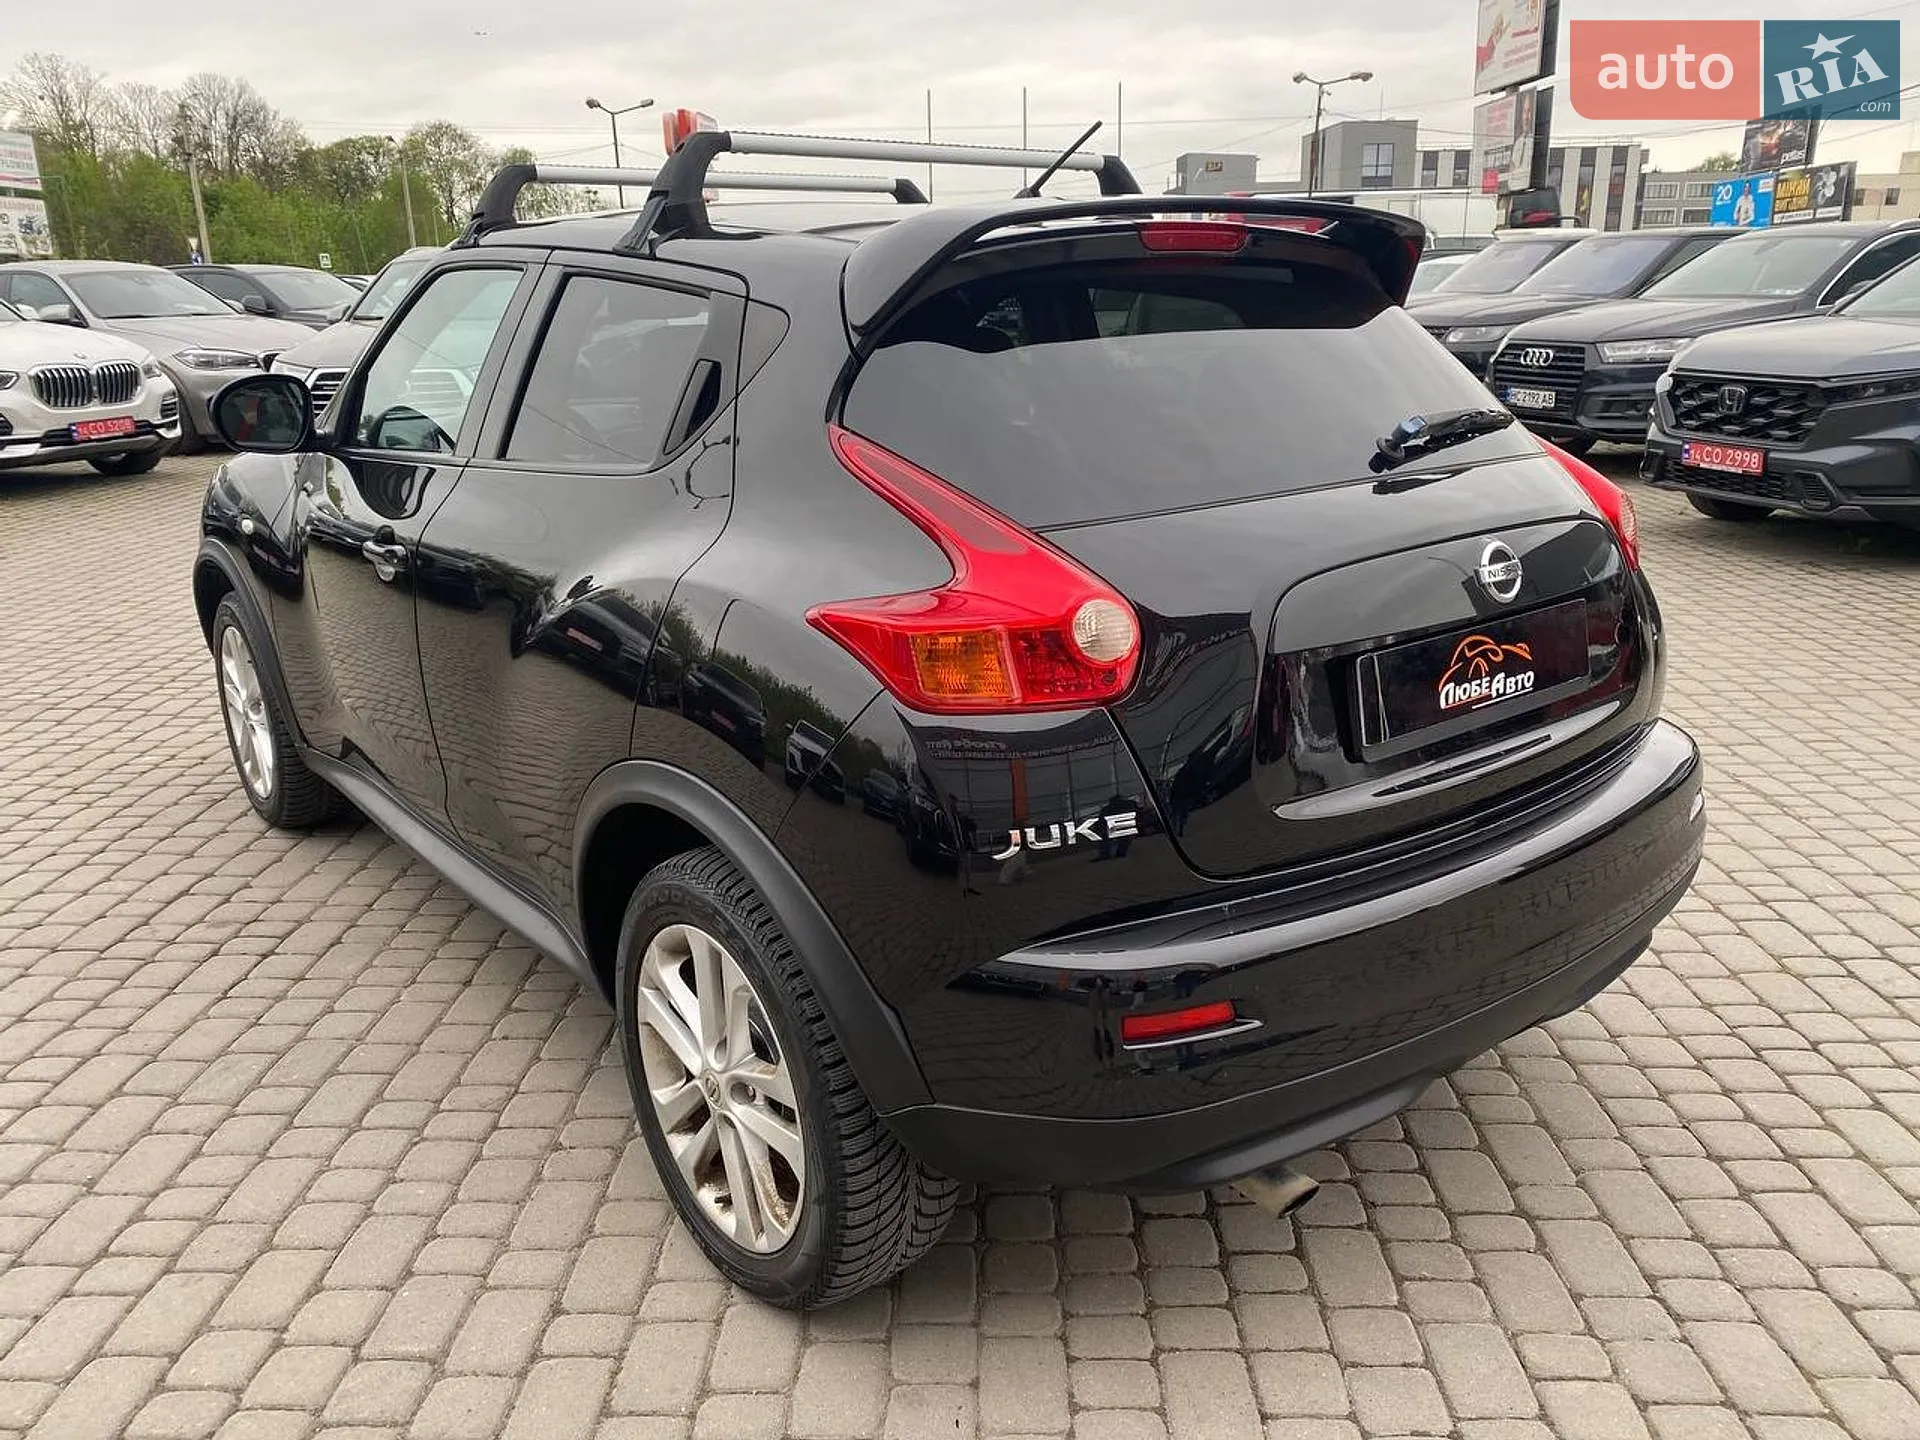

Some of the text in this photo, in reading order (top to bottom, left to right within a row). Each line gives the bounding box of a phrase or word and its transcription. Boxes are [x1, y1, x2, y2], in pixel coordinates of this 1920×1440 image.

[1690, 446, 1760, 469] 14 CO 2998
[991, 811, 1139, 861] JUKE
